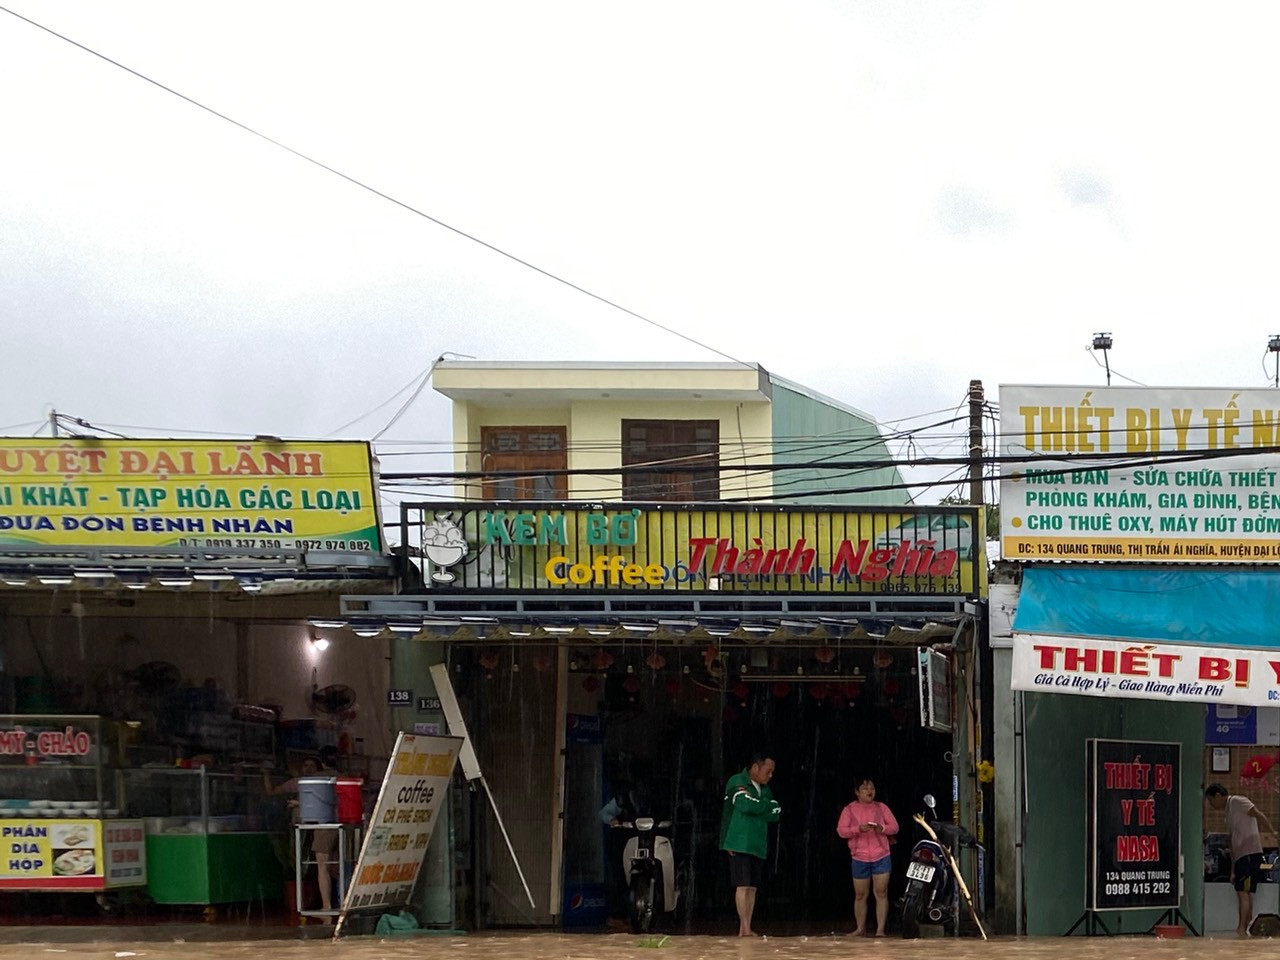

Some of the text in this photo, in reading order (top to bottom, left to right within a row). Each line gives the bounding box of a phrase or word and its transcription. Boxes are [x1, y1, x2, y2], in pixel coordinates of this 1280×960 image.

[1019, 391, 1114, 454] THIẾT
[1126, 408, 1160, 463] BỊ
[1171, 409, 1192, 451] Y
[1203, 393, 1240, 450] TẾ
[120, 450, 196, 480] ĐẠI
[207, 445, 323, 476] LÃNH
[1026, 469, 1065, 485] MUA
[1133, 466, 1169, 486] SỬA
[1175, 469, 1223, 486] CHỮA
[1228, 467, 1277, 487] THIẾT
[21, 481, 89, 507] KHÁT
[116, 487, 167, 512] TẠP
[176, 484, 232, 508] HÓA
[239, 485, 293, 510] CÁC
[301, 489, 361, 515] LOẠI
[1026, 488, 1088, 507] PHÒNG
[1094, 490, 1152, 510] KHÁM,
[1158, 493, 1188, 508] GIA
[1193, 491, 1242, 511] ĐÌNH,
[132, 515, 205, 533] BỆNH
[483, 511, 568, 546] KEM
[1027, 514, 1063, 530] CHO
[1069, 513, 1112, 531] THUÊ
[1118, 516, 1154, 534] OXY,
[1160, 514, 1198, 532] MÁY
[1204, 514, 1237, 532] HÚT
[236, 539, 255, 548] 337
[259, 539, 280, 548] 350
[295, 540, 322, 550] 0972
[326, 540, 347, 550] 974
[349, 540, 371, 550] 882
[1037, 543, 1054, 554] 134
[1056, 543, 1088, 555] QUANG
[1091, 544, 1125, 555] TRUNG,
[1128, 544, 1143, 557] THỊ
[1145, 540, 1170, 555] TRẤN
[1174, 543, 1183, 555] ÁI
[1186, 543, 1218, 556] NGHĨA,
[1220, 543, 1250, 557] HUYỆN
[1254, 545, 1270, 558] ĐẠI
[545, 555, 665, 586] Coffee
[688, 537, 817, 576] Thành
[832, 539, 959, 582] Nghĩa
[1033, 645, 1182, 678] THIẾT
[1198, 655, 1252, 688] BỊ
[390, 691, 409, 701] 138
[1034, 673, 1053, 685] Giá
[1072, 676, 1093, 692] Hợp
[1118, 679, 1143, 691] Giao
[1145, 681, 1175, 696] Hàng
[1204, 684, 1225, 697] Phí
[421, 699, 440, 709] 136
[37, 725, 90, 755] CHÁO
[1216, 724, 1229, 734] 4G
[1104, 755, 1173, 795] THIẾT BỊ
[397, 779, 434, 804] coffee
[1121, 791, 1156, 826] Y TẾ
[1117, 835, 1160, 862] NASA
[1106, 871, 1170, 880] 134 QUANG TRUNG
[1105, 882, 1170, 895] 0988 415 292
